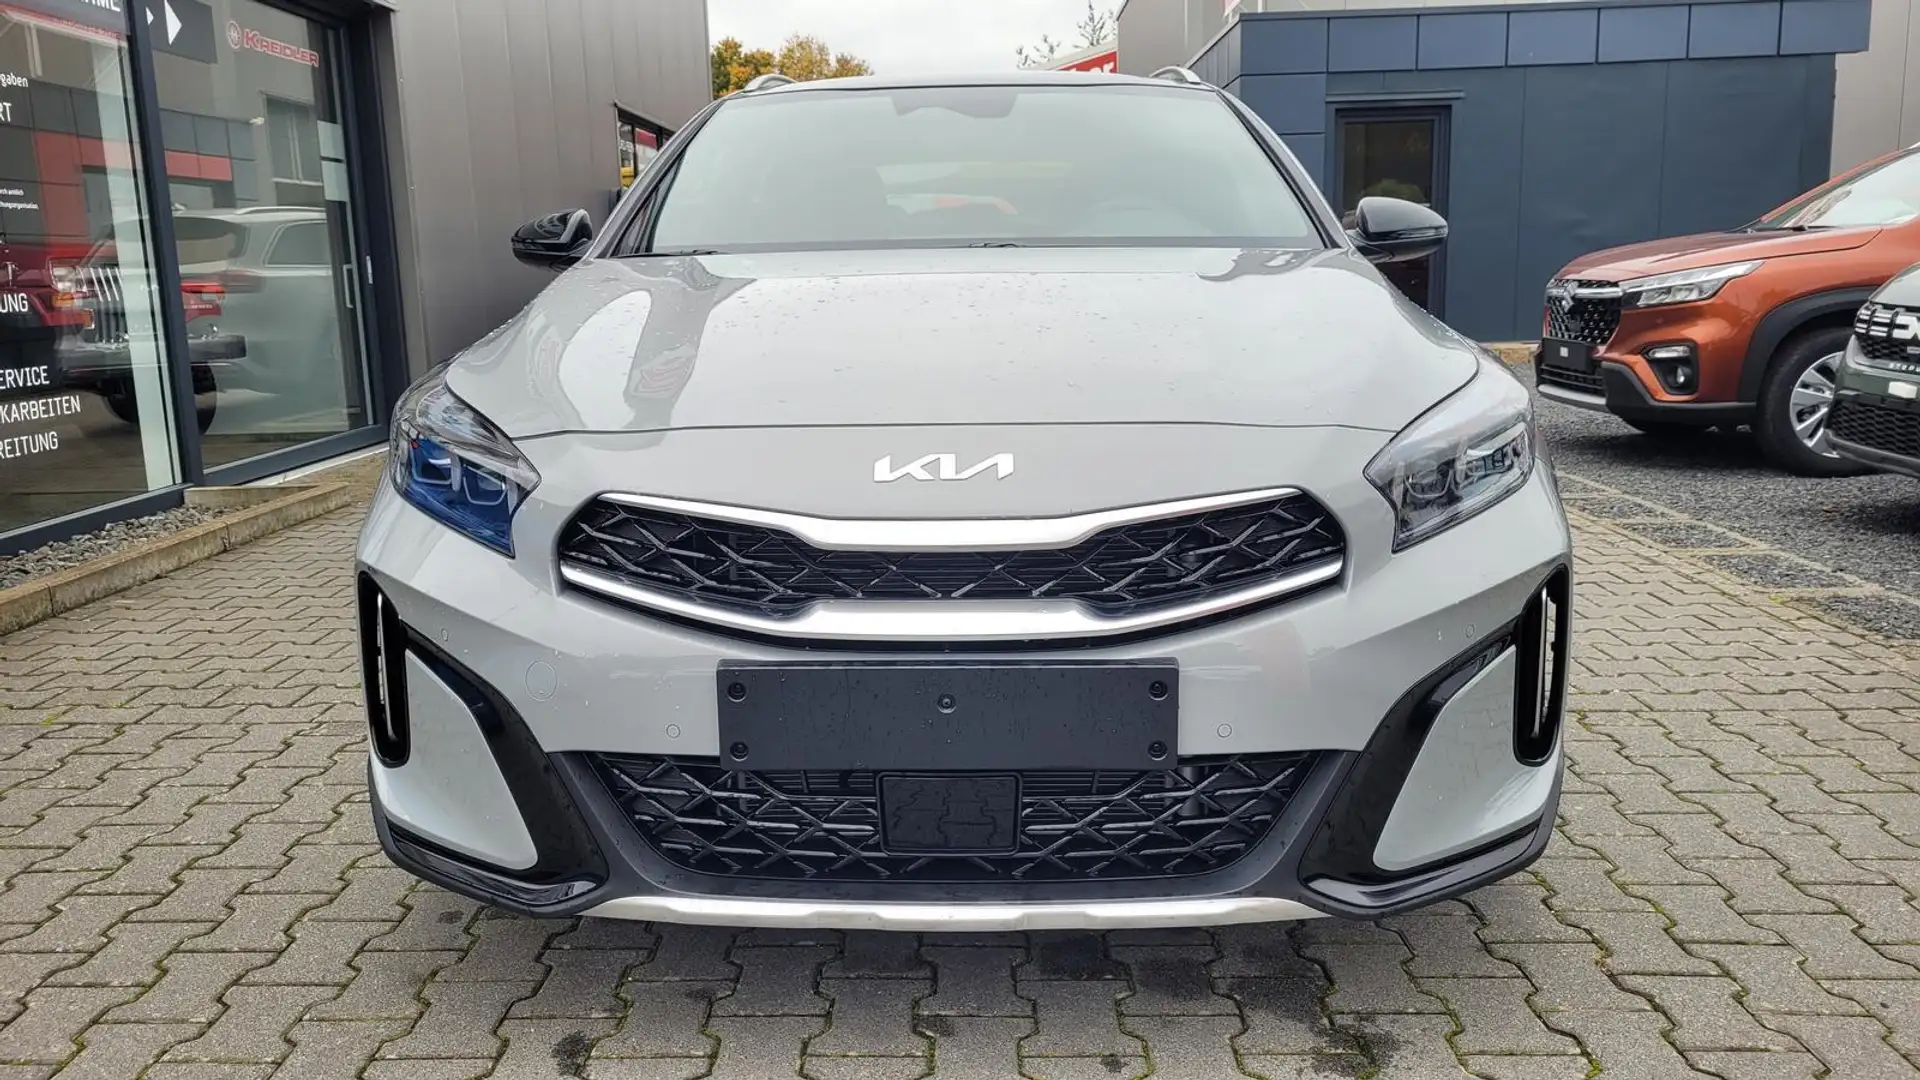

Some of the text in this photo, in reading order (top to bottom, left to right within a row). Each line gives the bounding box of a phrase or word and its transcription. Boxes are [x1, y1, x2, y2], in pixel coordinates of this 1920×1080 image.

[243, 28, 319, 68] KREIDLER
[0, 395, 81, 424] KARBEITEN
[873, 453, 1015, 483] KIA
